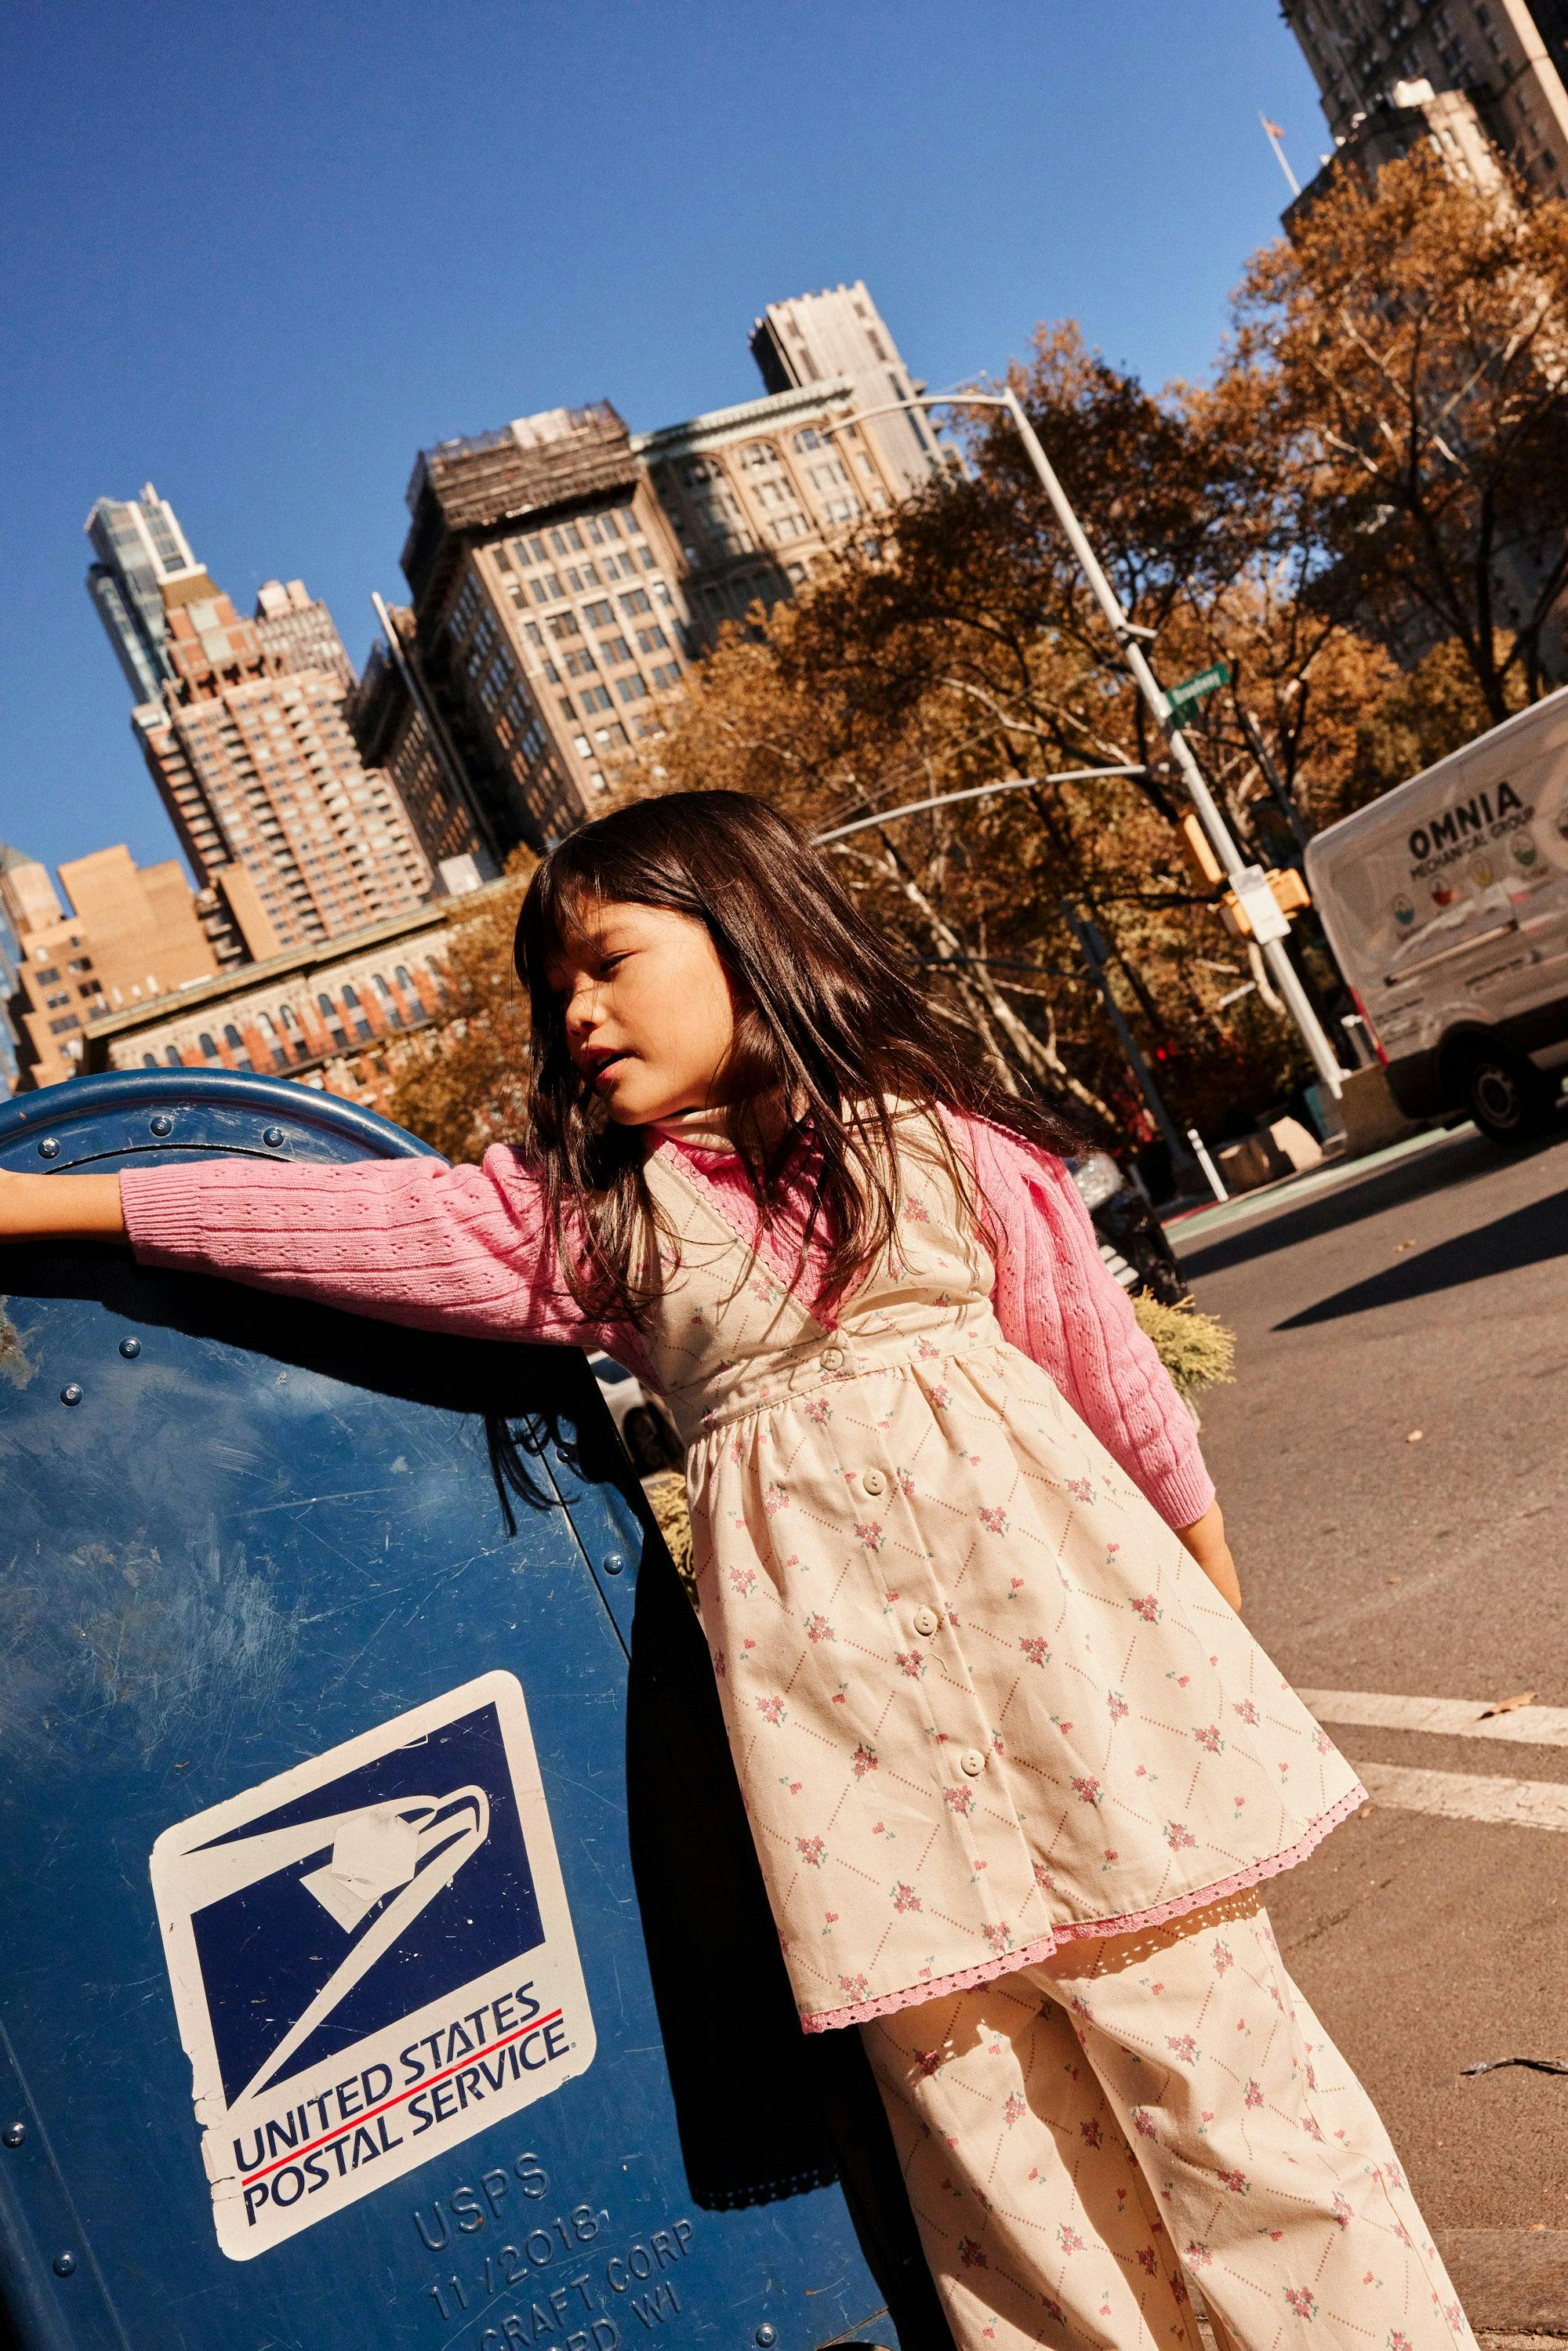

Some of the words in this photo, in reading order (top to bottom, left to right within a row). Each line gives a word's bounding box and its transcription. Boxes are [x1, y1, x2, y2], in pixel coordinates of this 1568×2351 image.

[1409, 781, 1523, 859] OMNIA
[233, 2063, 392, 2172] UNITED
[400, 1981, 540, 2086] STATES
[242, 2116, 404, 2227] POSTAL
[414, 2152, 549, 2251] USPS
[606, 2218, 694, 2293] CORP
[631, 2280, 681, 2330] WI
